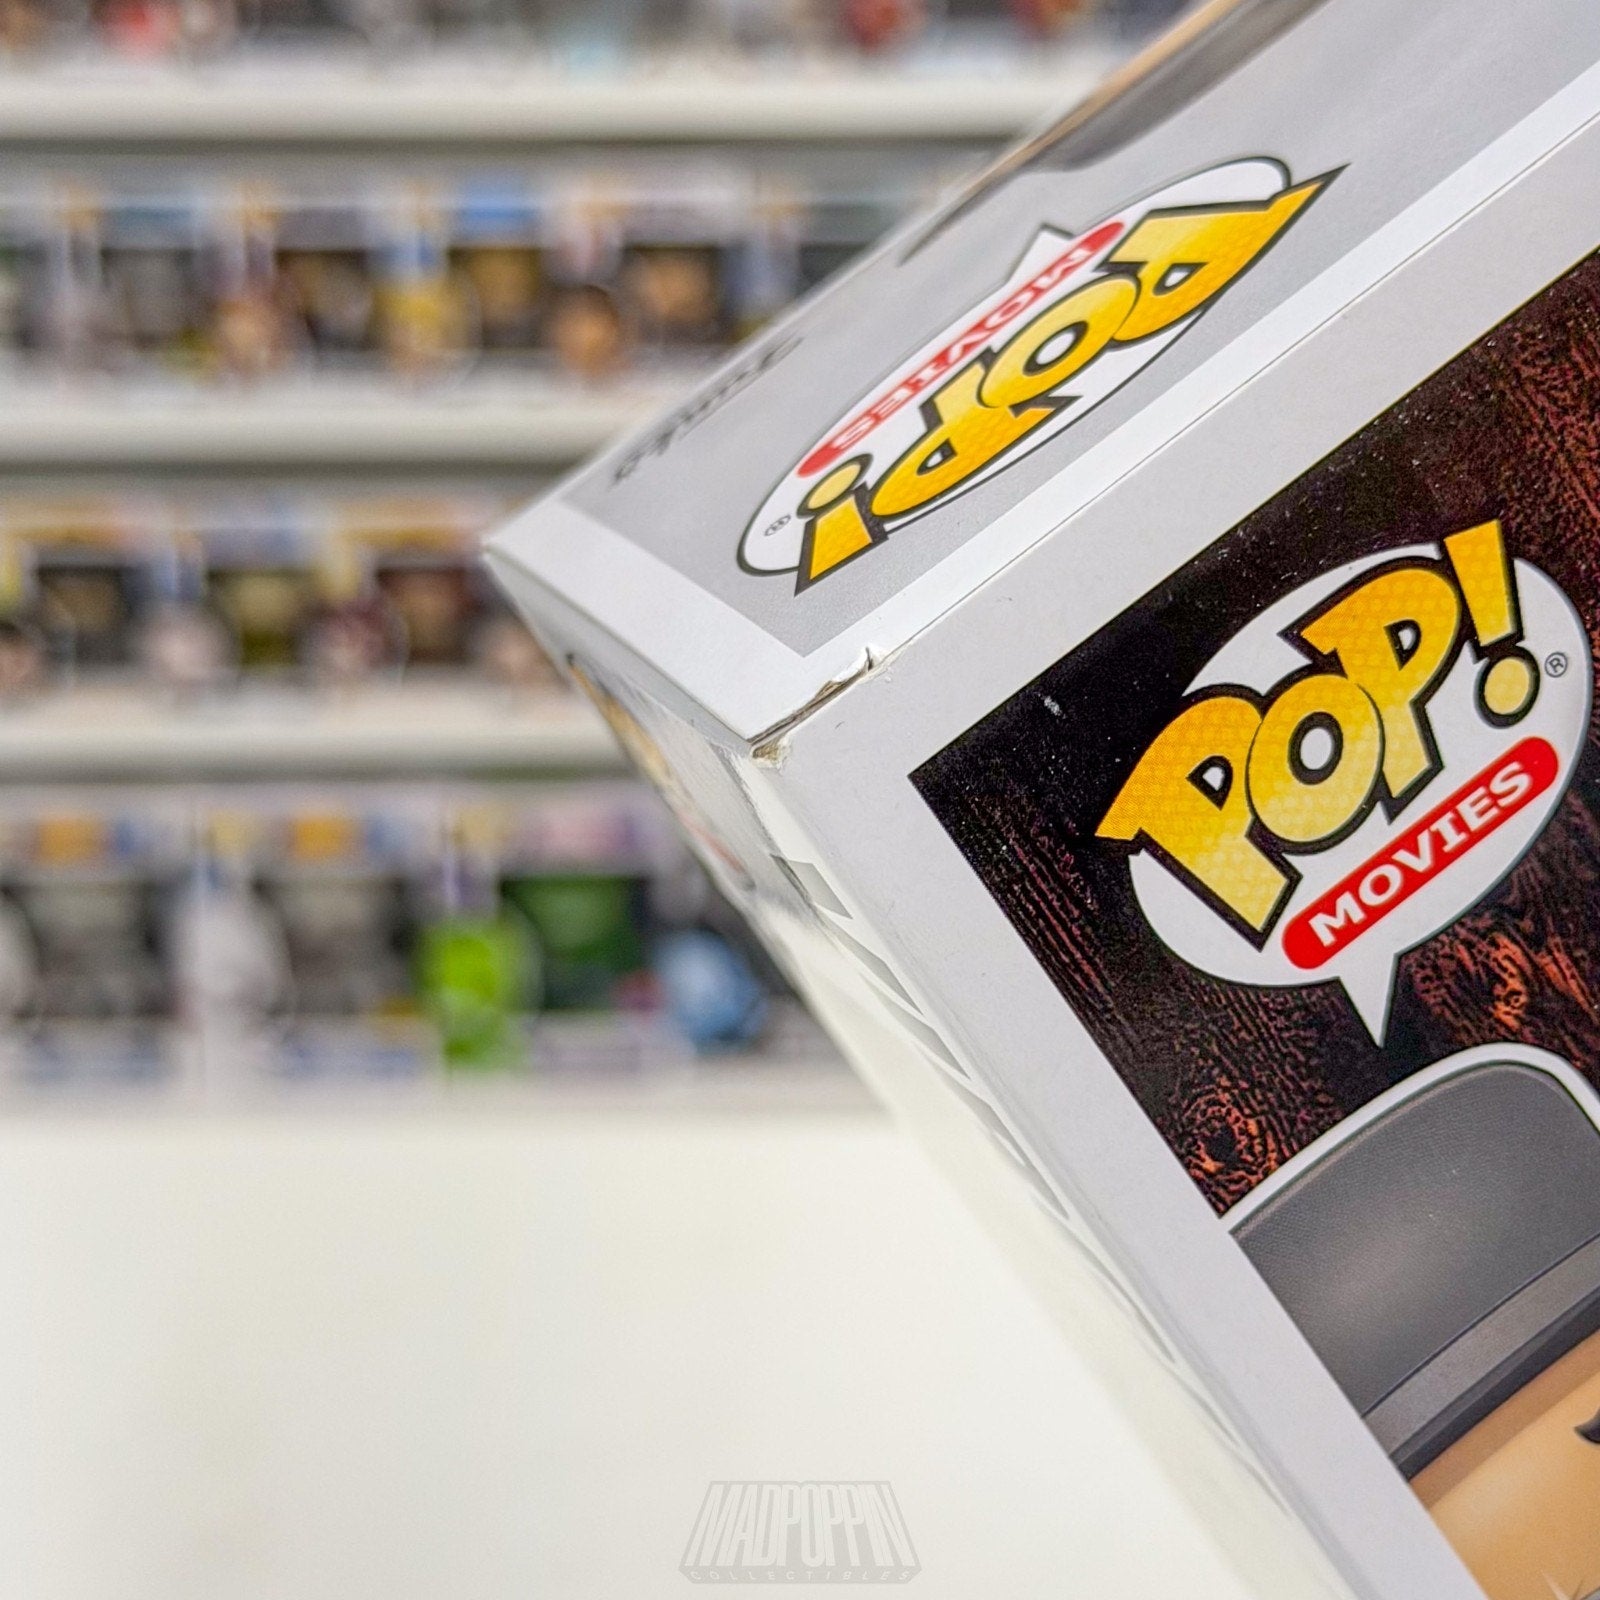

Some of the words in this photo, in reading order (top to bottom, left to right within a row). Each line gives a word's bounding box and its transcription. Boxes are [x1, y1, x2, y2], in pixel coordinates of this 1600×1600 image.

[794, 164, 1350, 596] POP!
[833, 247, 1093, 450] MOVIES
[1095, 518, 1541, 952] POP!
[1308, 760, 1533, 948] MOVIES
